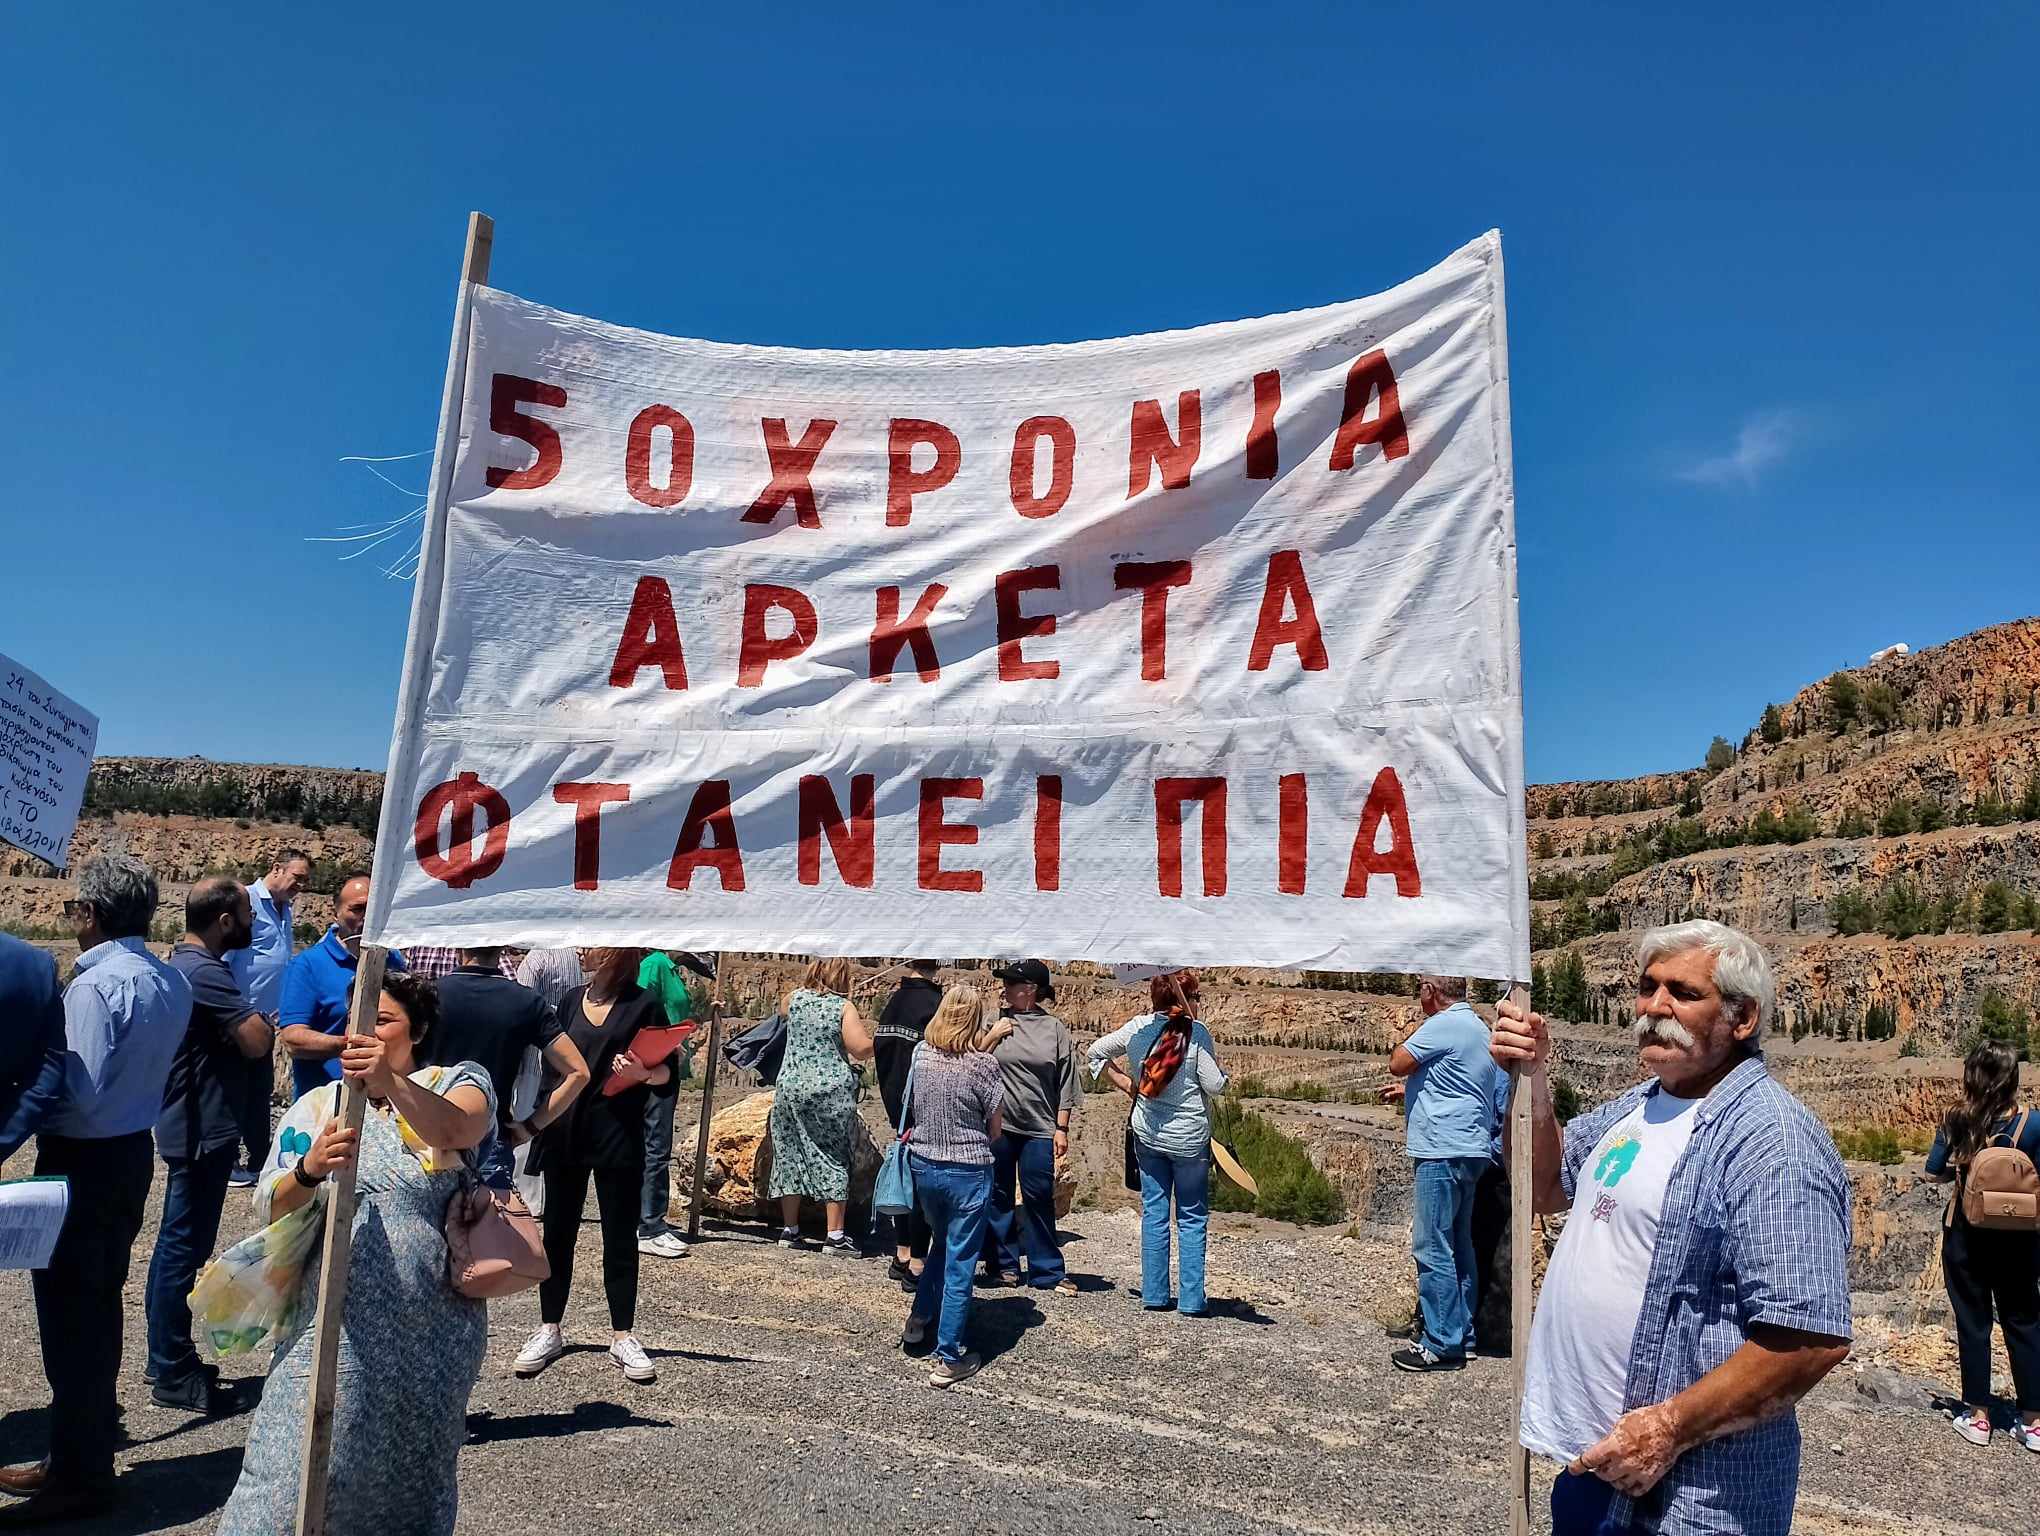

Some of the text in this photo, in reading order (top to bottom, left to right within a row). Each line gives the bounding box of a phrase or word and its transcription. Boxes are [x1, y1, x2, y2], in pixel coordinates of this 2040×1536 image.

[608, 549, 1328, 691] ΑΡΚΕΤΑ
[413, 765, 1422, 899] ΦΤΑΝΕΙ ΠΙΑ
